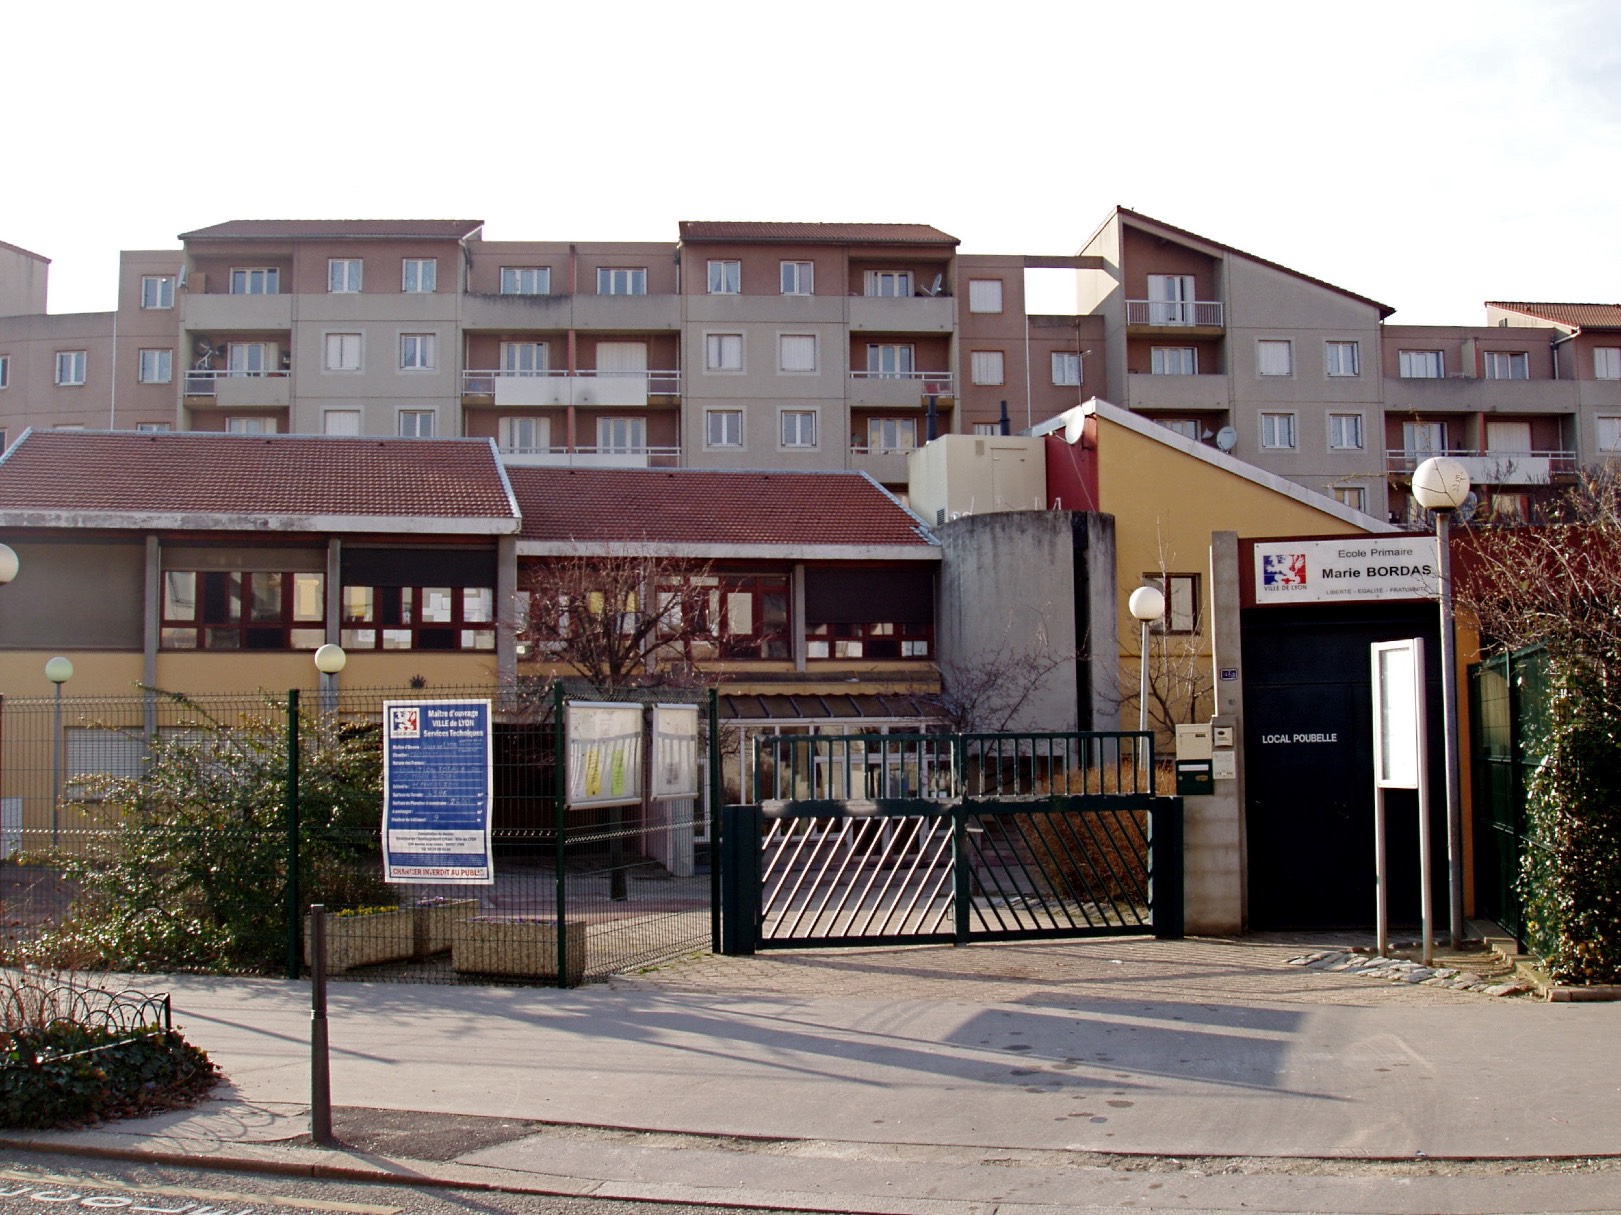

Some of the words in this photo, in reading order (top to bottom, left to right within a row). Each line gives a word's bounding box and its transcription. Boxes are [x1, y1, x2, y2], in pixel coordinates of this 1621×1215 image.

[1338, 550, 1366, 559] Ecole
[1370, 548, 1413, 556] Primaire
[1322, 568, 1361, 579] Marie
[1367, 564, 1432, 577] BORDAS
[1262, 734, 1291, 744] LOCAL
[1293, 733, 1337, 743] POUBELLE
